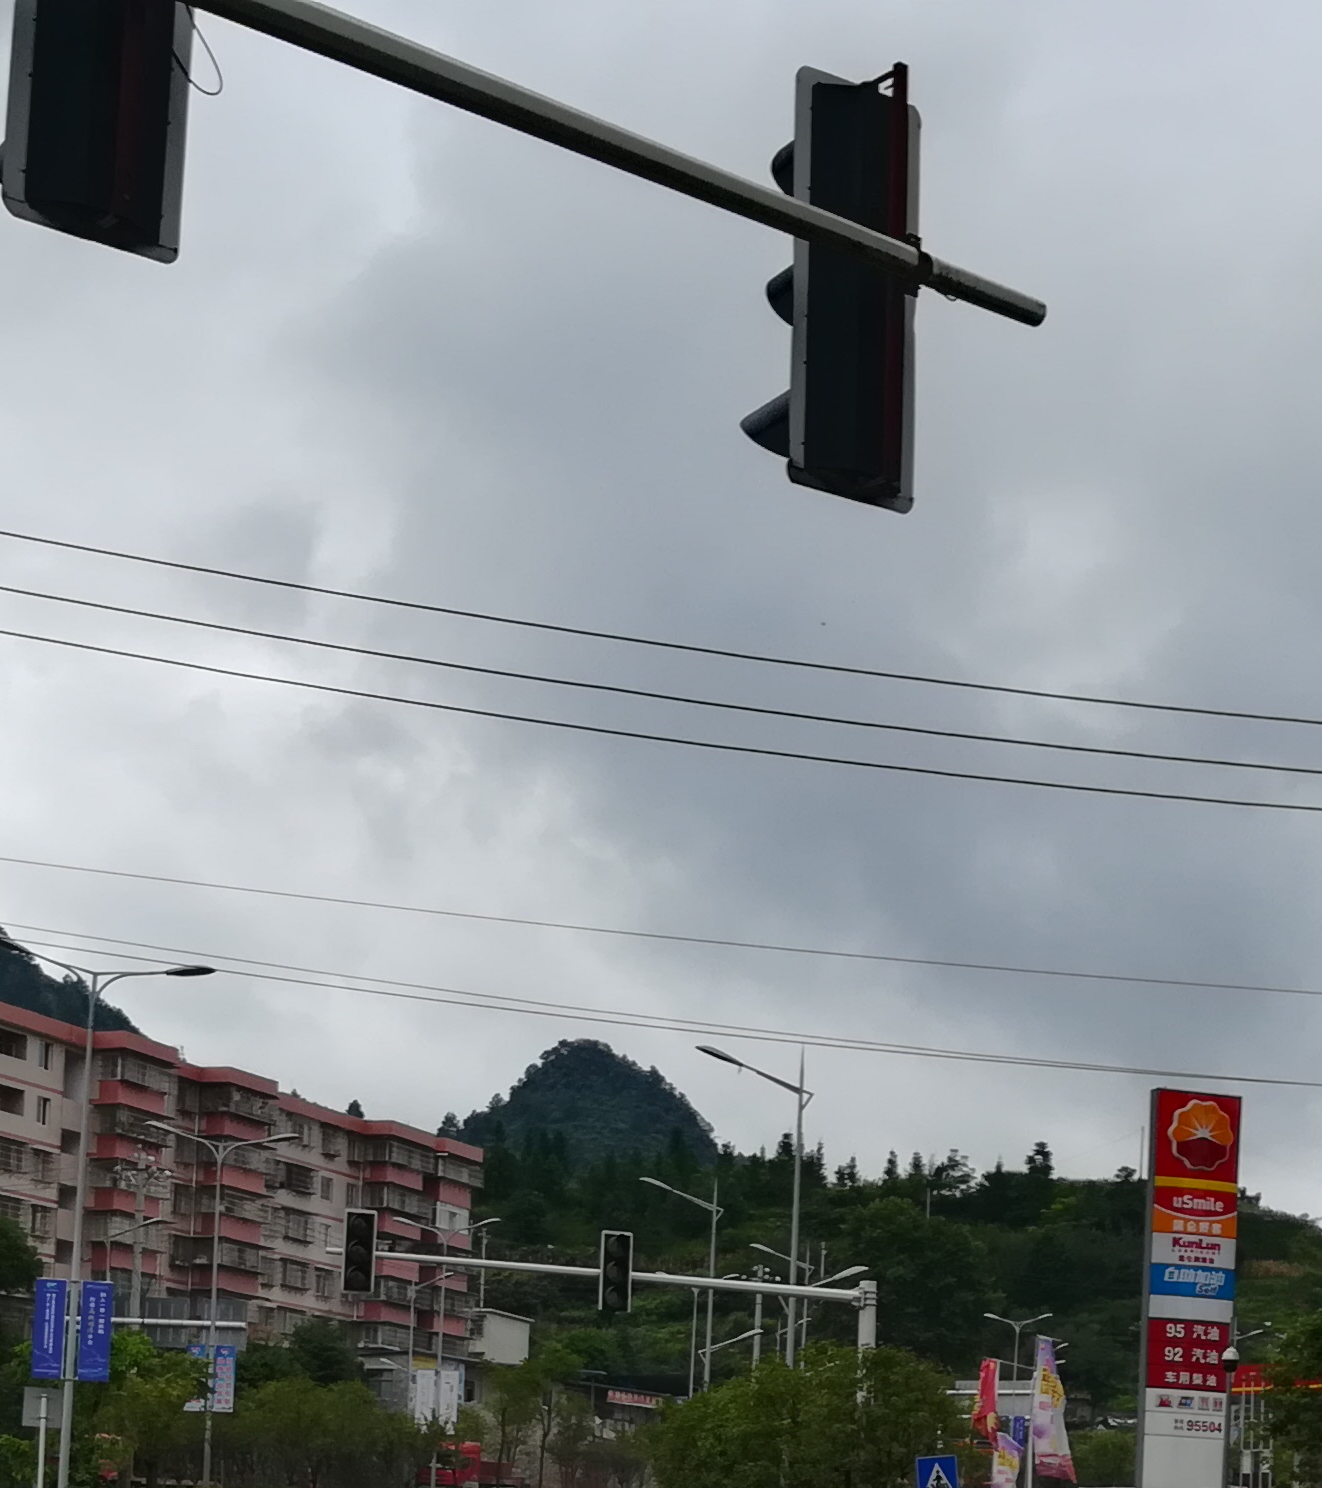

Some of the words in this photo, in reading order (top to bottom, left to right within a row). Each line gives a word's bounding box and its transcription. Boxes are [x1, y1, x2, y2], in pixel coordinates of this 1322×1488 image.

[1172, 1194, 1224, 1212] uSmile
[1166, 1323, 1185, 1338] 95
[1192, 1324, 1220, 1341] 汽油
[1164, 1346, 1184, 1362] 92
[1191, 1348, 1219, 1365] 汽油
[1164, 1371, 1217, 1387] 车用柴油
[1186, 1419, 1222, 1433] 95504
